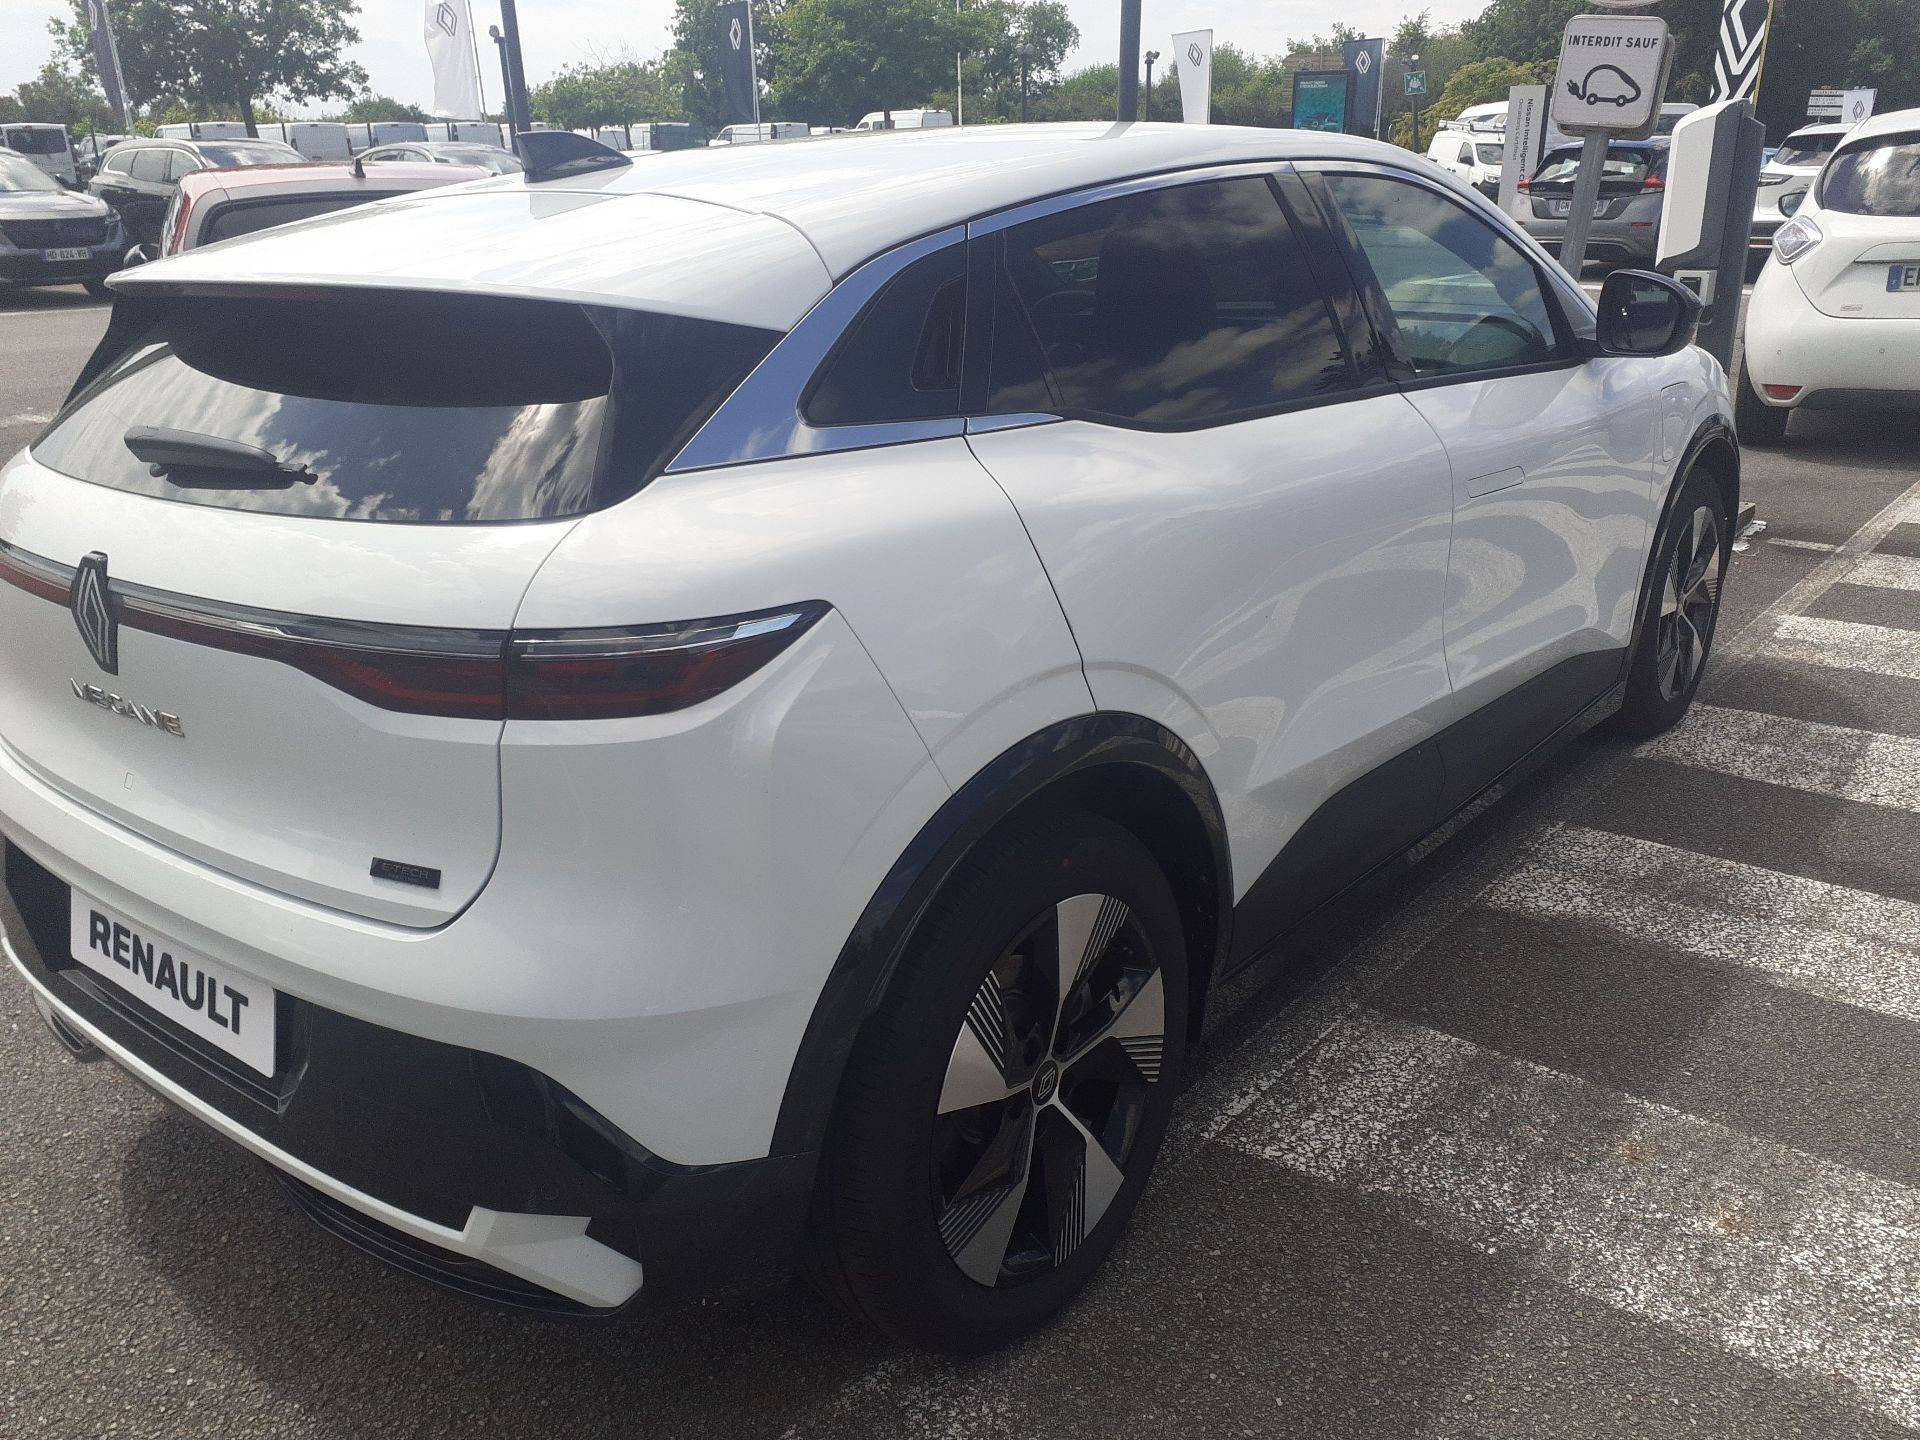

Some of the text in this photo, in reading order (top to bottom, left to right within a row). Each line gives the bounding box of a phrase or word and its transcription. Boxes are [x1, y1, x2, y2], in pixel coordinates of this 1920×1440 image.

[1568, 35, 1659, 49] INTERDIT SAUF
[1524, 98, 1534, 130] Nissan
[1519, 130, 1530, 173] Intelligent
[90, 909, 249, 1035] RENAULT
